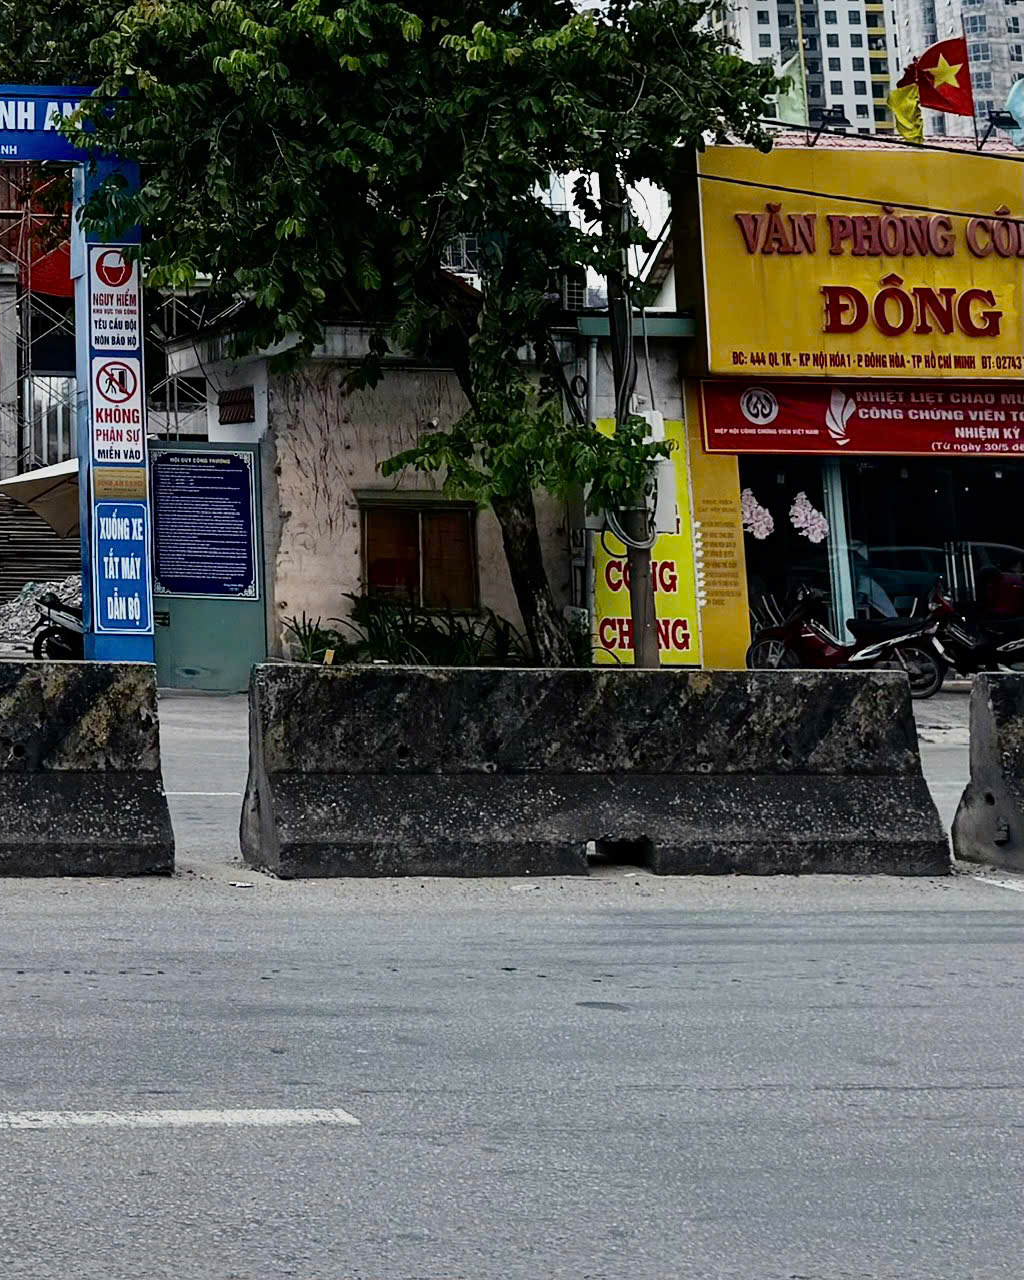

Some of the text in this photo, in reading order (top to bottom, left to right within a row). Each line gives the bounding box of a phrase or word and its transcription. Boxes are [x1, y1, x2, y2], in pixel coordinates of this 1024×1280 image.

[735, 202, 1024, 258] VĂN PHÒNG CÔ
[93, 288, 137, 307] NGUY HIỂM
[821, 272, 1003, 337] ĐÔNG
[94, 318, 107, 330] YÊU
[125, 319, 137, 332] ĐỘI
[111, 333, 125, 346] BẢO
[127, 334, 137, 348] HỘ
[732, 351, 747, 366] ĐC:
[768, 352, 779, 366] QL
[781, 352, 792, 367] 1K
[799, 353, 810, 367] KP
[812, 351, 828, 370] NỘI
[829, 351, 847, 368] HÓA
[864, 352, 887, 369] ĐÔNG
[888, 352, 906, 369] HÒA
[924, 350, 937, 369] HỒ
[938, 353, 952, 369] CHÍ
[953, 355, 976, 370] MINH
[96, 405, 140, 425] KHÔNG
[858, 406, 1006, 422] CÔNG CHỨNG VIÊN
[96, 428, 140, 446] PHẬN SỰ
[954, 425, 1000, 441] NHIỆM
[97, 445, 141, 460] MIỄN VÀO
[984, 443, 1009, 452] 30/5
[99, 508, 143, 541] XUỐNG XE
[103, 548, 141, 580] TẮT MÁY
[605, 560, 678, 593] CG
[107, 587, 141, 626] DẪN BỘ
[599, 618, 691, 651] CHNG
